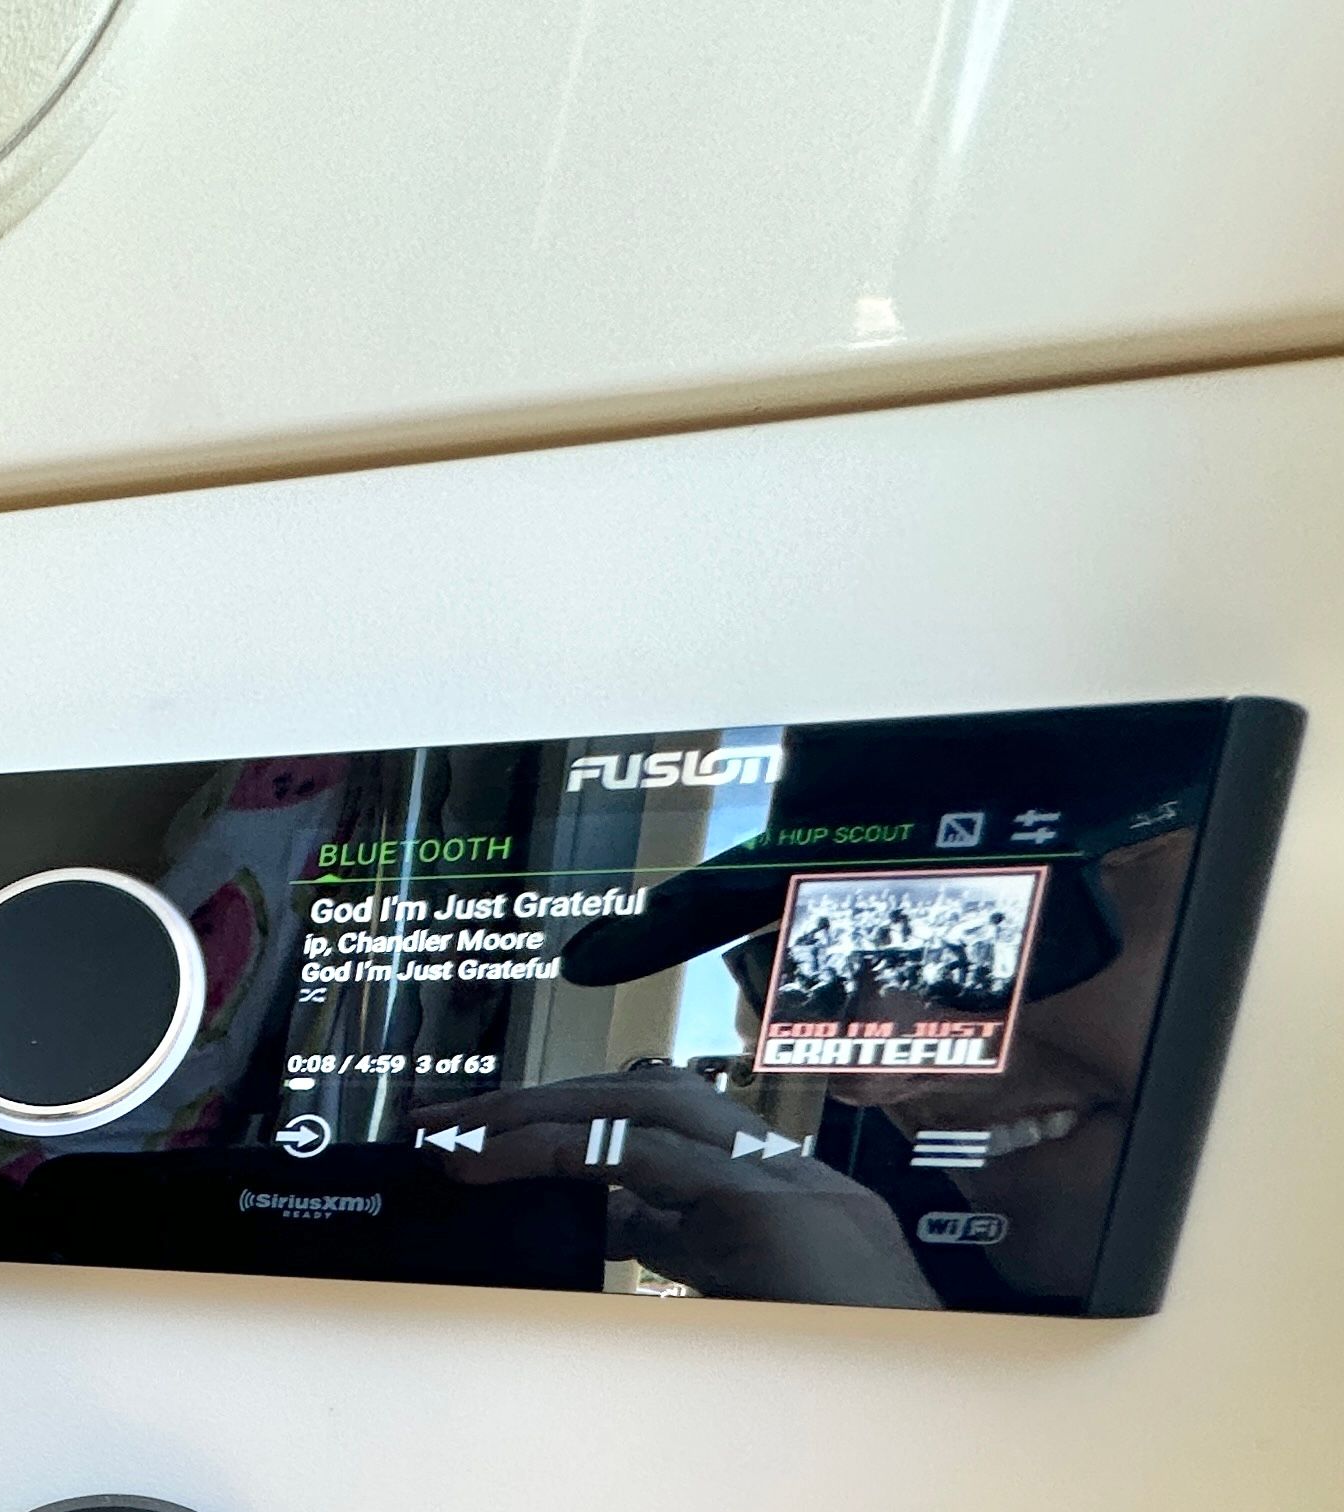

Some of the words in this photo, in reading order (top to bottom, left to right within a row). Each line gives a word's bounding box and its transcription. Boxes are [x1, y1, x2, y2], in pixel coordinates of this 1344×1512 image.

[566, 744, 783, 793] FUSION
[832, 824, 914, 844] SCOUT
[318, 836, 512, 867] BLUETOOTH
[311, 895, 374, 924] God
[380, 895, 428, 922] I'm
[433, 892, 509, 921] Just
[513, 886, 648, 918] Grateful
[304, 933, 333, 959] ip,
[338, 929, 453, 954] Chandler
[457, 929, 545, 951] Moore
[301, 961, 352, 983] God
[355, 961, 392, 981] I'm
[397, 959, 454, 981] Just
[458, 956, 562, 981] Grateful
[768, 1022, 839, 1037] GOD
[901, 1022, 1004, 1037] JUST
[287, 1055, 336, 1073] 0:08
[355, 1054, 406, 1074] 4:59
[415, 1055, 433, 1074] 3
[435, 1053, 463, 1074] of
[464, 1055, 496, 1074] 63
[763, 1038, 998, 1066] GRATEFUL
